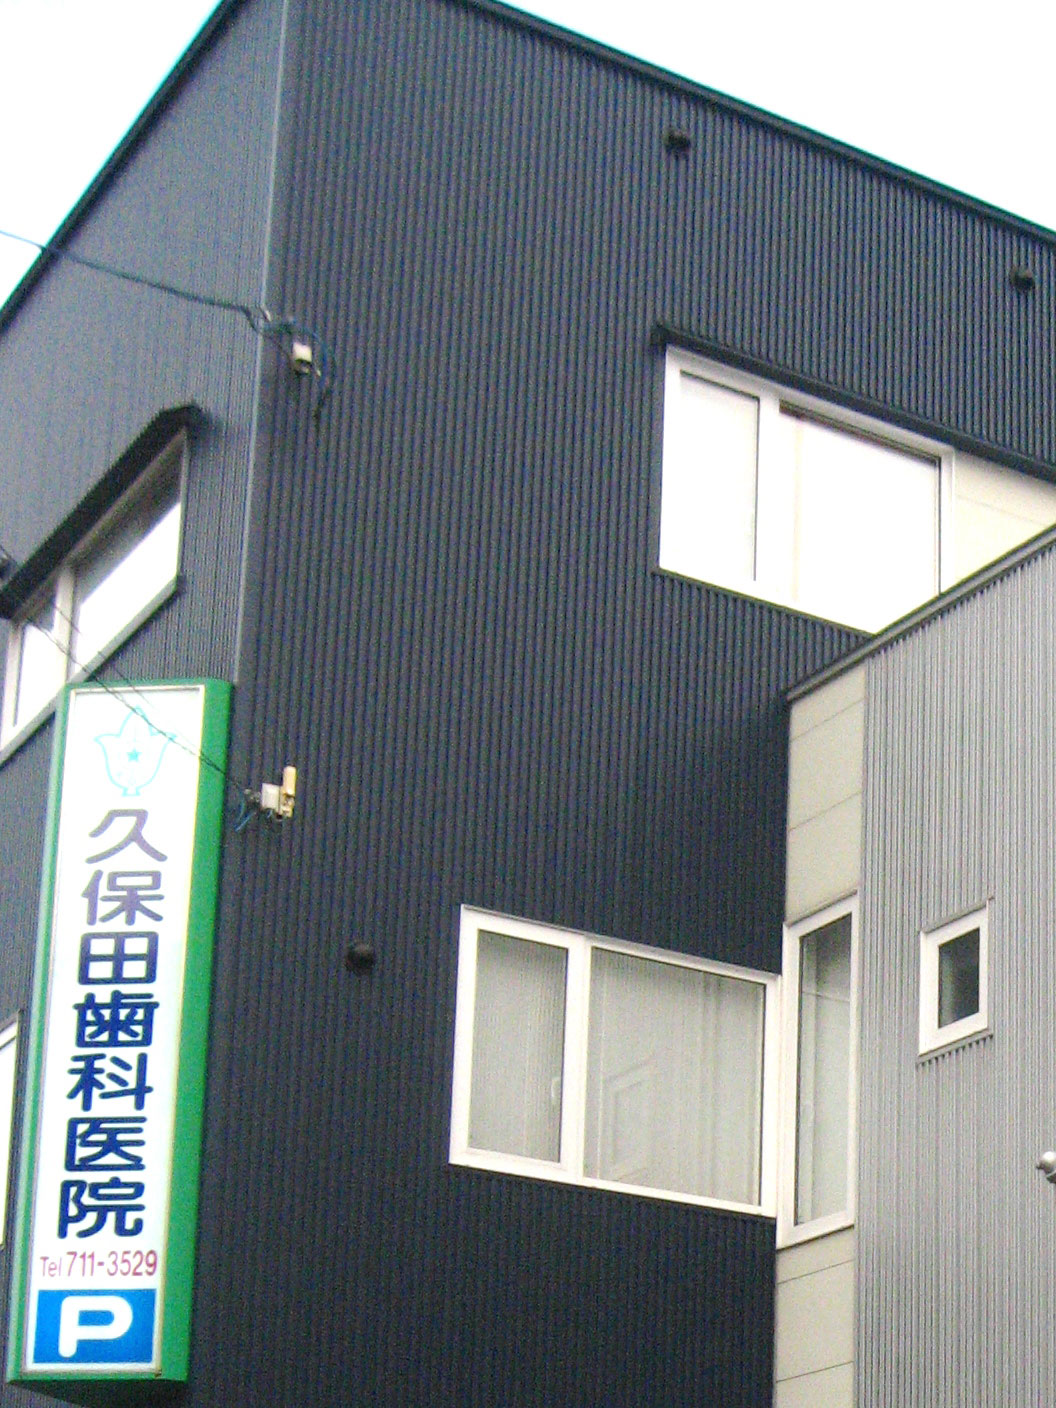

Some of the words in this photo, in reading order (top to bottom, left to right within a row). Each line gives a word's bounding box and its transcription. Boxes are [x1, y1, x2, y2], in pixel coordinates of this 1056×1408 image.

[56, 808, 168, 1240] 久保田歯科医院
[40, 1256, 62, 1277] Tel
[66, 1250, 158, 1277] 711-3529
[58, 1295, 133, 1358] P
